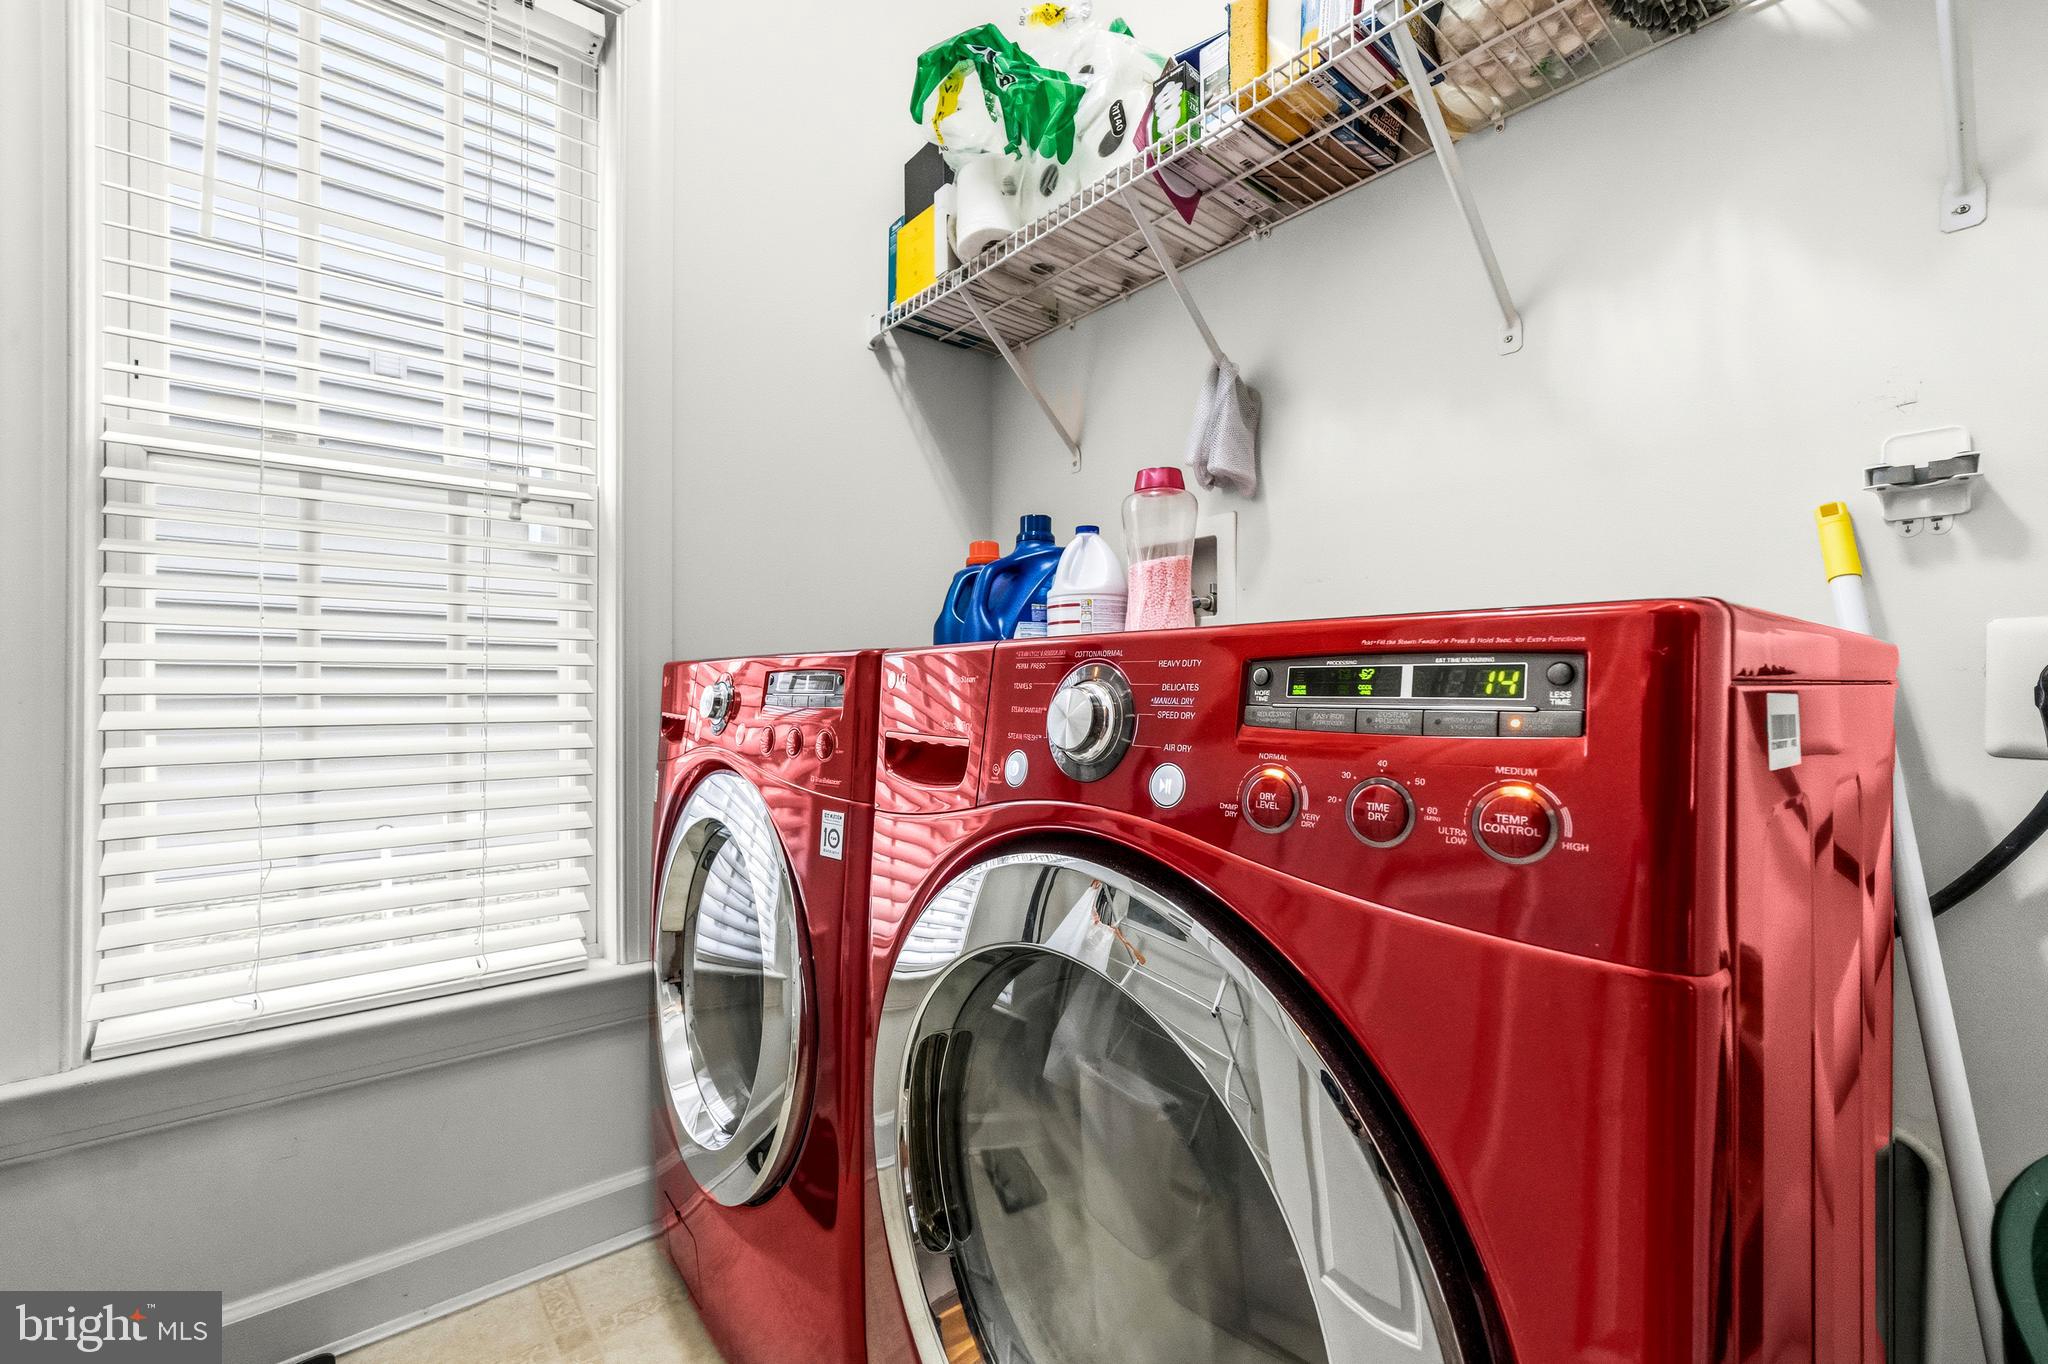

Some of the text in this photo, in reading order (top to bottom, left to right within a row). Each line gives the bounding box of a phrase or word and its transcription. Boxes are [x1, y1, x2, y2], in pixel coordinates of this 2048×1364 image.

[1527, 635, 1547, 643] Extra
[1548, 635, 1586, 643] Functions
[1158, 659, 1202, 668] HEAVY DUTY
[1013, 682, 1033, 690] TOWELS
[1161, 683, 1200, 691] DELICATES
[1485, 670, 1521, 695] 14
[1549, 690, 1572, 698] LESS
[1180, 697, 1195, 705] DRY
[1157, 711, 1196, 719] SPEED DRY
[1163, 743, 1192, 752] AIR DRY
[1258, 752, 1288, 761] NORMAL
[1341, 771, 1351, 779] 30
[1494, 766, 1538, 777] MEDIUM
[1414, 778, 1426, 786] 50
[1259, 792, 1277, 801] DRY
[1219, 802, 1239, 811] DAMP
[1255, 800, 1280, 810] LEVEL
[1366, 802, 1390, 812] TIME
[1224, 810, 1238, 818] DRY
[1426, 807, 1438, 815] 60
[1301, 813, 1320, 822] VERY
[1367, 811, 1388, 821] DRY
[1494, 813, 1529, 825] TEMP.
[1301, 820, 1316, 829] DRY
[1438, 826, 1468, 837] ULTRA
[1483, 823, 1542, 838] CONTROL
[1445, 836, 1467, 846] LOW
[1561, 842, 1590, 852] HIGH
